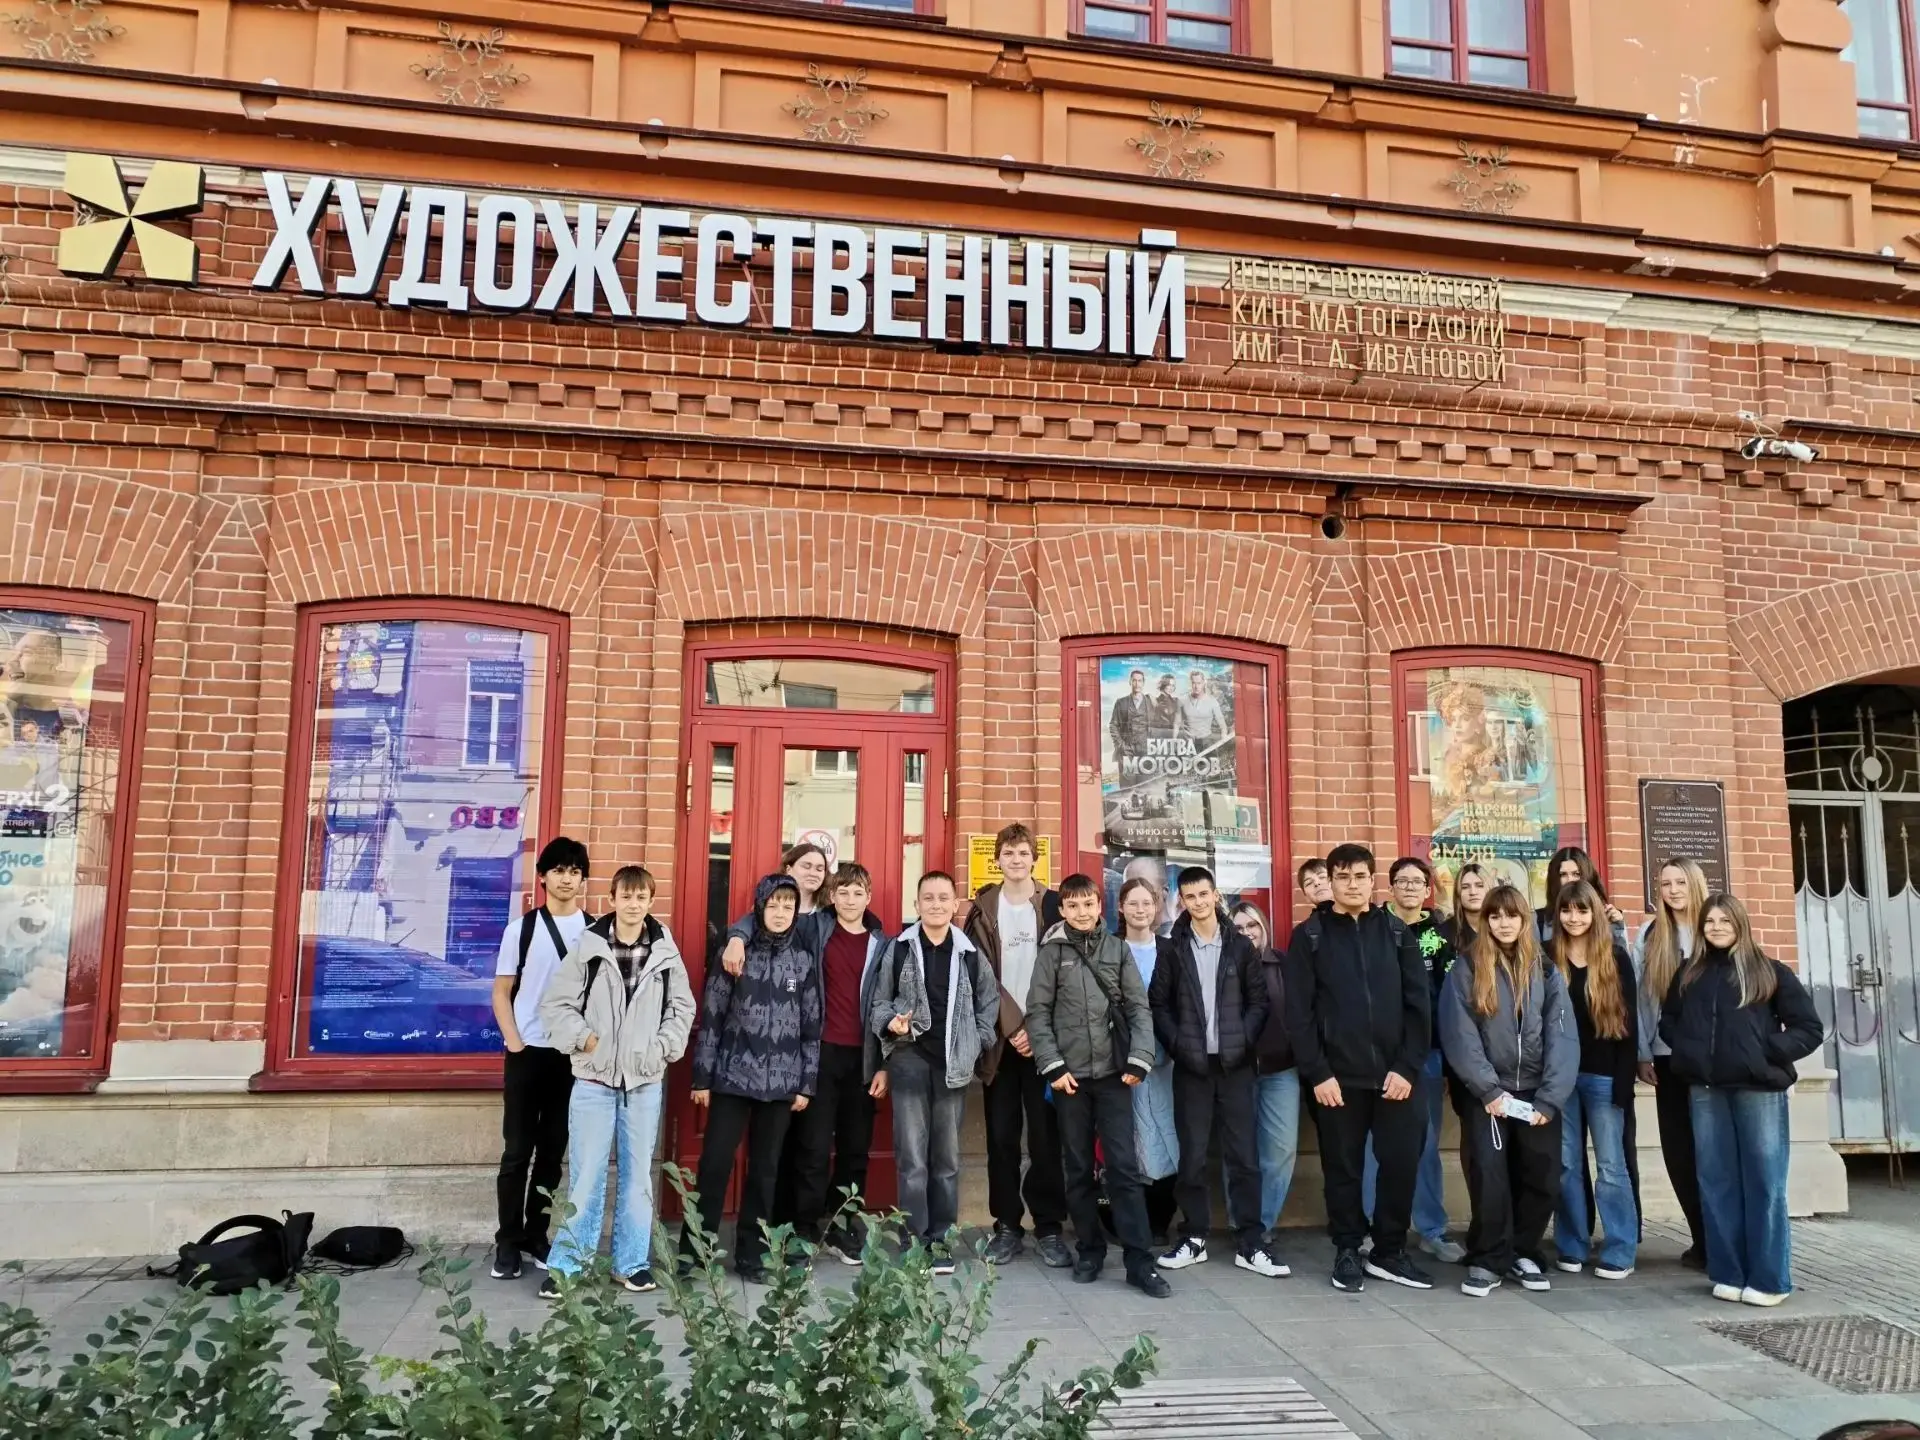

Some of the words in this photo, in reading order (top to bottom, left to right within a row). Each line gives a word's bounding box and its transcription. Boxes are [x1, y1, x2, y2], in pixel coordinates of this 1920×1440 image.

[252, 171, 1186, 359] ХУДОЖЕСТВЕННЫЙ
[1230, 257, 1318, 295] ЦЕНТР
[1330, 267, 1502, 312] РОССИЙСКОЙ
[1231, 292, 1505, 347] КИНЕМАТОГРАФИИ
[1365, 341, 1507, 382] ИВАНОВОЙ
[1146, 738, 1197, 756] БИТВА
[1122, 755, 1221, 775] МОТОРОВ
[0, 790, 41, 806] ЕРХ!
[43, 783, 70, 813] 2
[1463, 801, 1526, 819] ЦАРЕВНА
[1460, 819, 1533, 833] НЕСМЕЯНА
